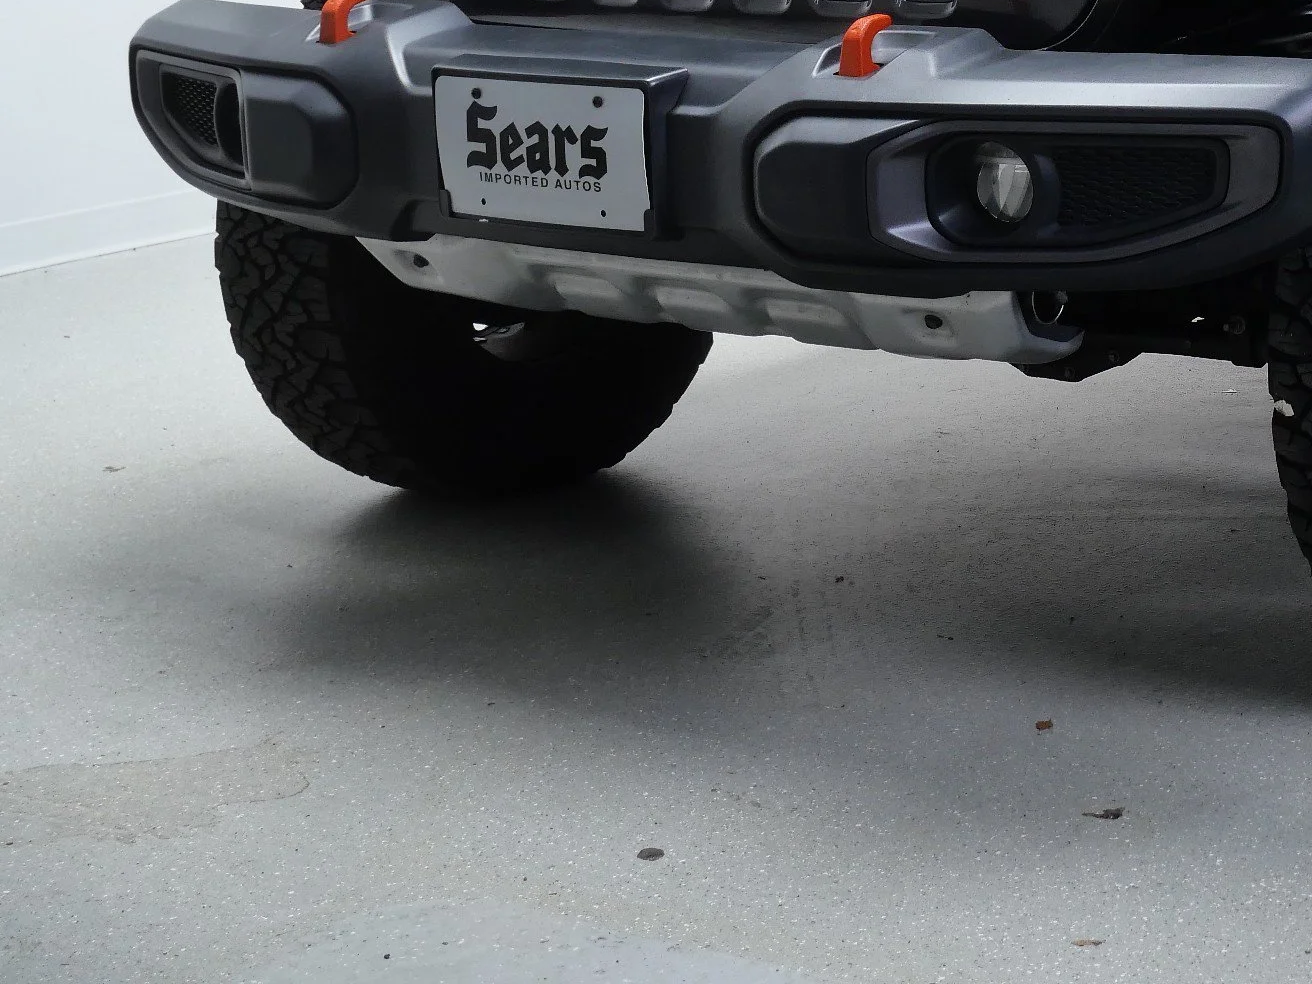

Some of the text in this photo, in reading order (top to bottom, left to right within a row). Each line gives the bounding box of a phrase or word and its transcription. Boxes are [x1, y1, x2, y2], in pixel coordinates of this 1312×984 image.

[466, 100, 608, 180] Sears
[479, 171, 602, 193] IMPORTED AUTOS
